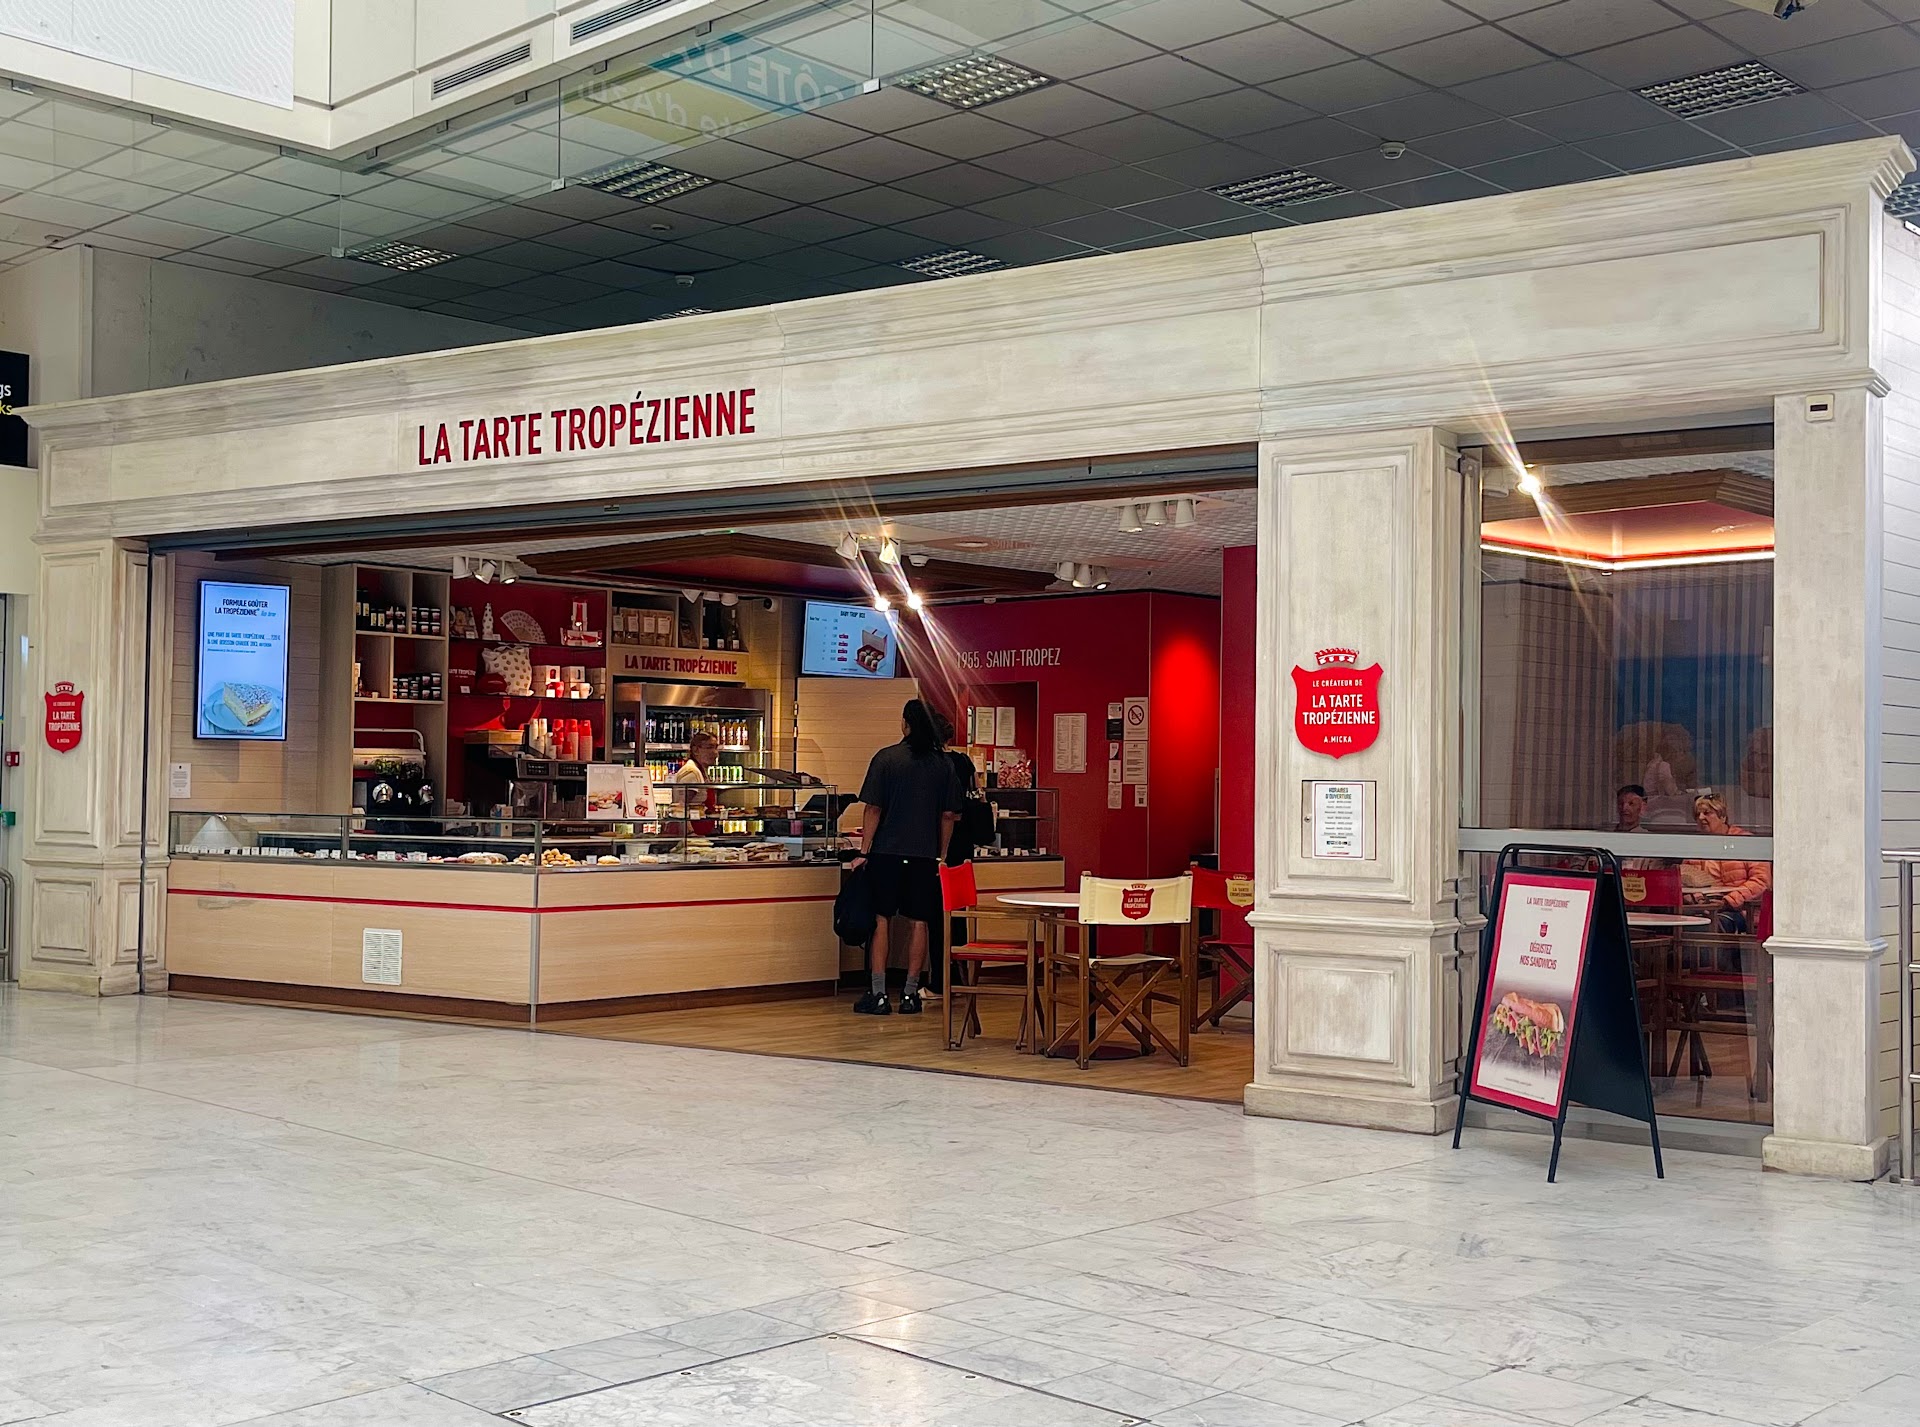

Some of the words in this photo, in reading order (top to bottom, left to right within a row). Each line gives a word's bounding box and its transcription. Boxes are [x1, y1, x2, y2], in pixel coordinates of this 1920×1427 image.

[419, 423, 452, 466] LA
[459, 412, 542, 462] TARTE
[550, 388, 756, 453] TROPÉZIENNE
[248, 599, 268, 608] GOÛTER
[624, 654, 638, 669] LA
[640, 656, 671, 672] TARTE
[672, 655, 737, 675] TROPÉZIENNE
[986, 648, 1061, 669] SAINT-TROPEZ
[1312, 680, 1320, 688] LE
[1321, 679, 1353, 687] CRÉATEUR
[1354, 679, 1363, 687] DE
[1312, 694, 1326, 708] LA
[1328, 694, 1363, 708] TARTE
[52, 711, 60, 720] LA
[60, 711, 75, 720] TARTE
[1302, 709, 1376, 725] TROPÉZIENNE
[48, 721, 80, 731] TROPÉZIENNE
[1526, 896, 1533, 905] LA
[1529, 941, 1553, 955] DÉGUSTEZ
[1519, 955, 1530, 966] NOS
